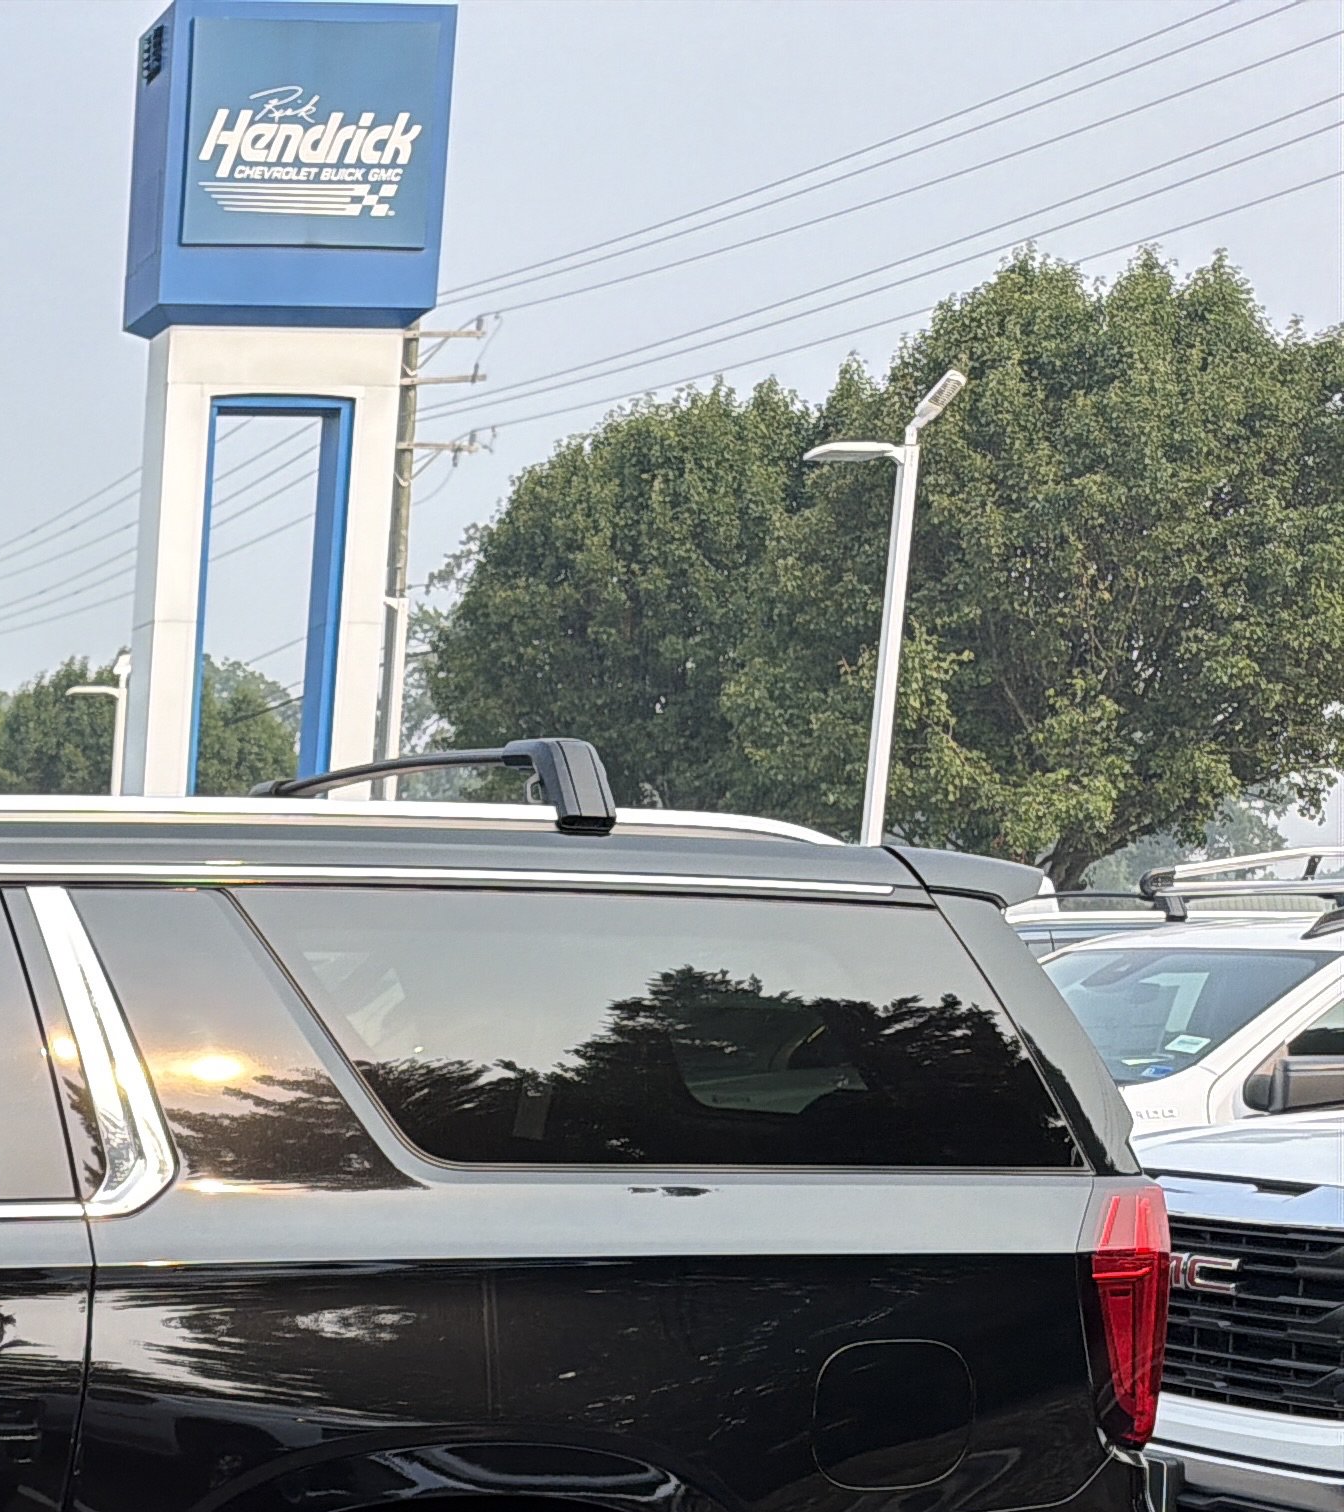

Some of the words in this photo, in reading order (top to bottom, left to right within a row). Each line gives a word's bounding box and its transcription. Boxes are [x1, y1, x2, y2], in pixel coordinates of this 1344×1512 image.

[199, 108, 422, 178] Hendrick
[233, 165, 318, 180] CHEVROLET
[319, 167, 365, 181] BUICK
[367, 168, 404, 182] GMC
